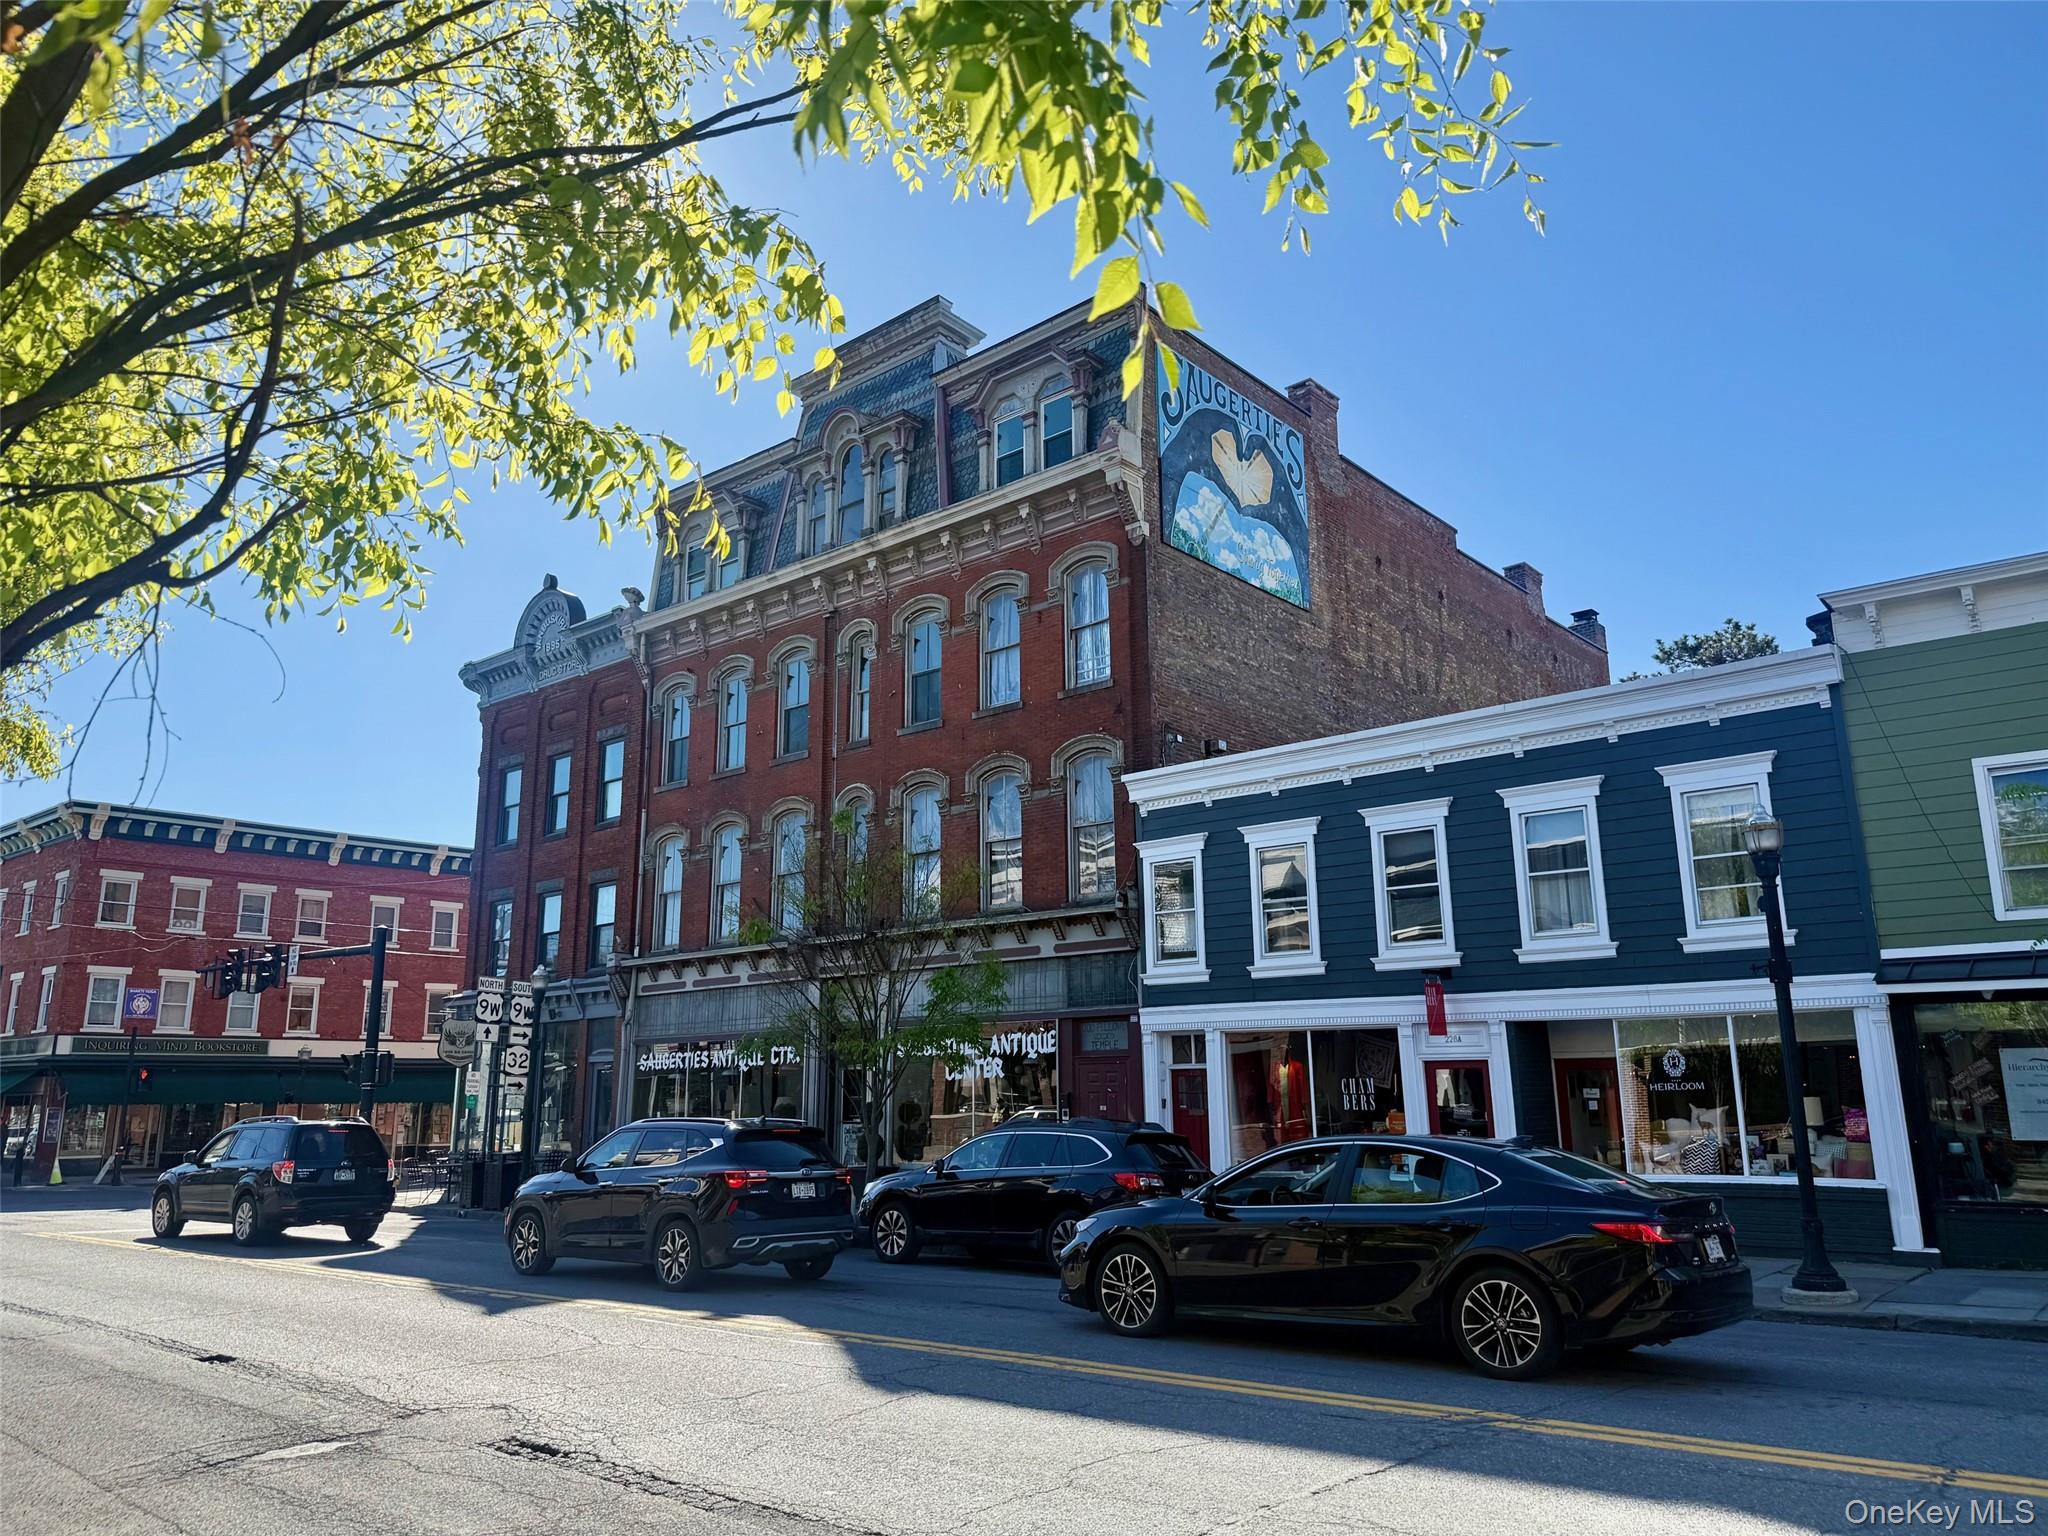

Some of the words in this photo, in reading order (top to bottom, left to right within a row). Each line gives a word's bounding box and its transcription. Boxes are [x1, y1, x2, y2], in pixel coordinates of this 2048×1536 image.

[1160, 350, 1304, 490] SAUGERTIES
[480, 979, 503, 990] NORTH
[479, 999, 501, 1017] 9W
[156, 1040, 188, 1051] MIND
[194, 1041, 258, 1052] BOOKSTORE
[990, 1030, 1056, 1059] ANTIQUE
[1091, 1039, 1119, 1049] TEMPLE
[507, 1052, 528, 1068] 32
[637, 1050, 709, 1072] SAUGERTIES
[770, 1045, 800, 1064] CTR.
[1341, 1078, 1375, 1094] CHAM
[1649, 1082, 1705, 1092] HEIRLOOM
[1343, 1094, 1376, 1111] BERS
